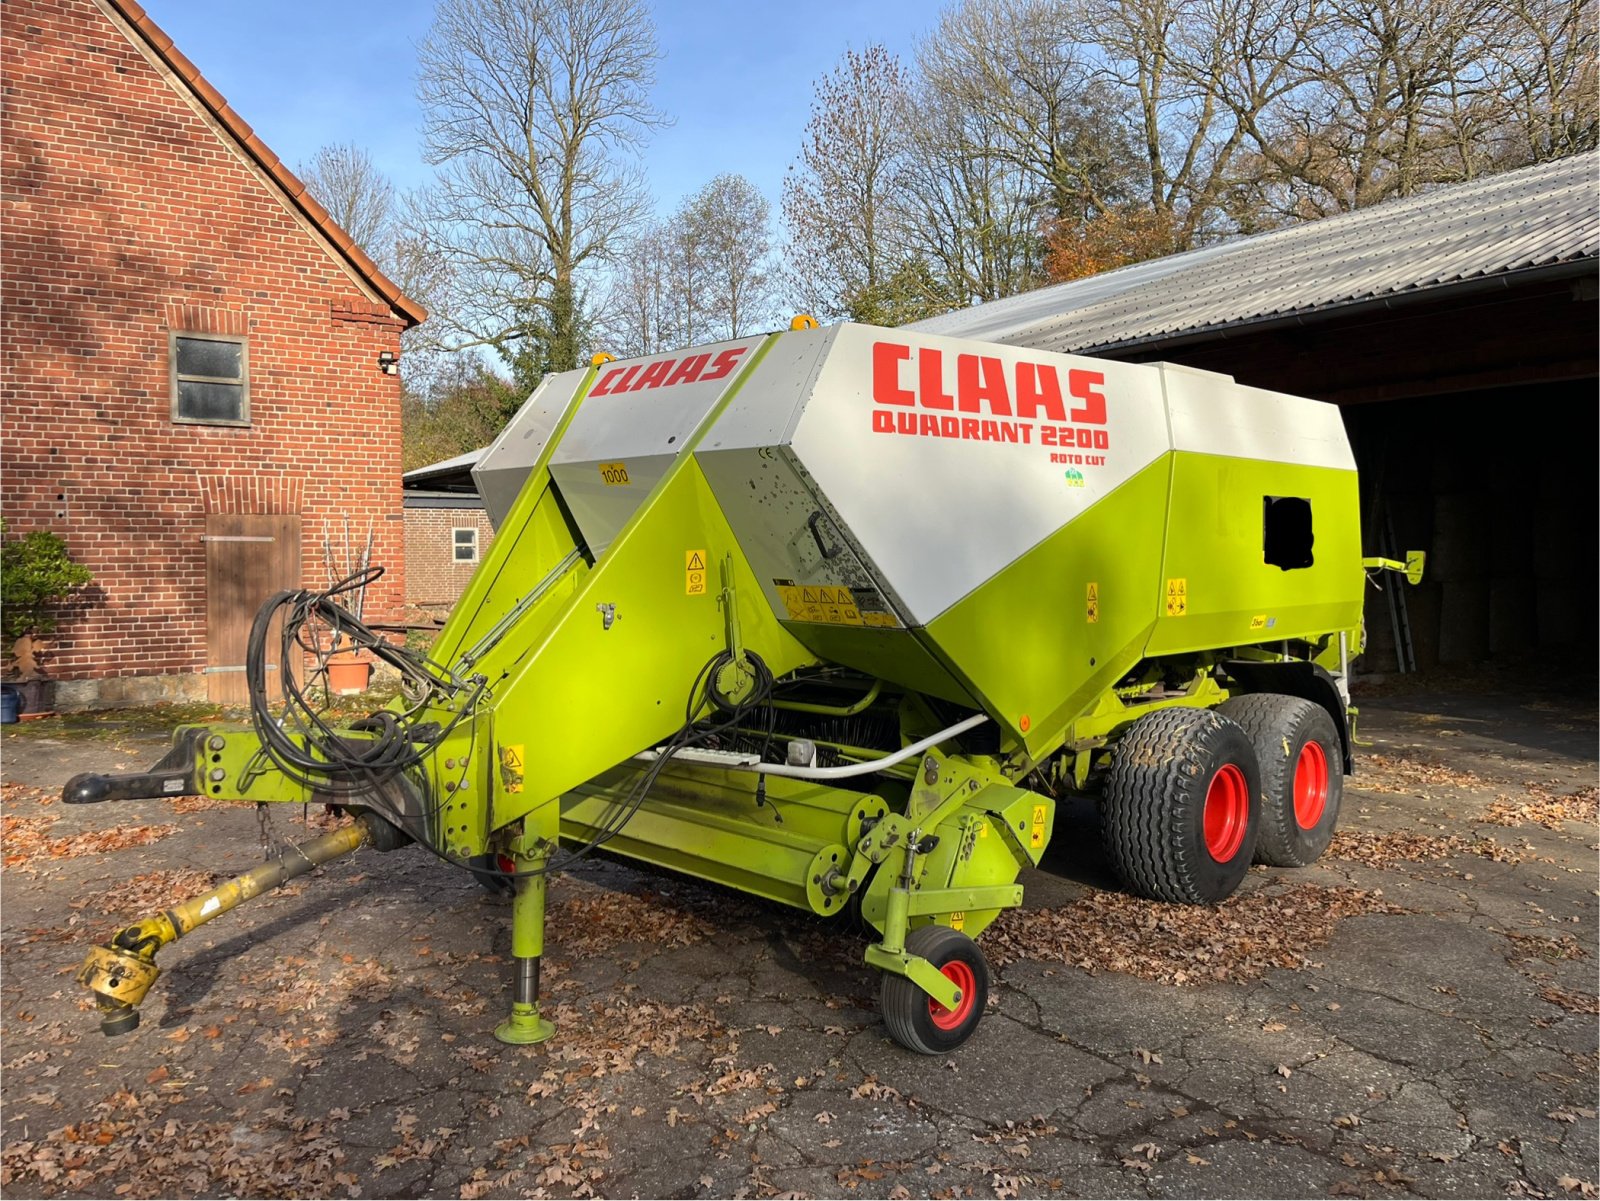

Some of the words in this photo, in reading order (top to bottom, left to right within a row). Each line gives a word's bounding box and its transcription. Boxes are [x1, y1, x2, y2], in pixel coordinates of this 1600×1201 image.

[588, 347, 748, 398] CLAAS
[872, 341, 1108, 425] CLAAS
[872, 410, 1033, 444] QUADRANT
[1040, 425, 1109, 449] 2200
[758, 447, 774, 460] CE
[1050, 453, 1082, 465] ROTO
[1085, 455, 1106, 466] CUT
[602, 469, 629, 483] 1000
